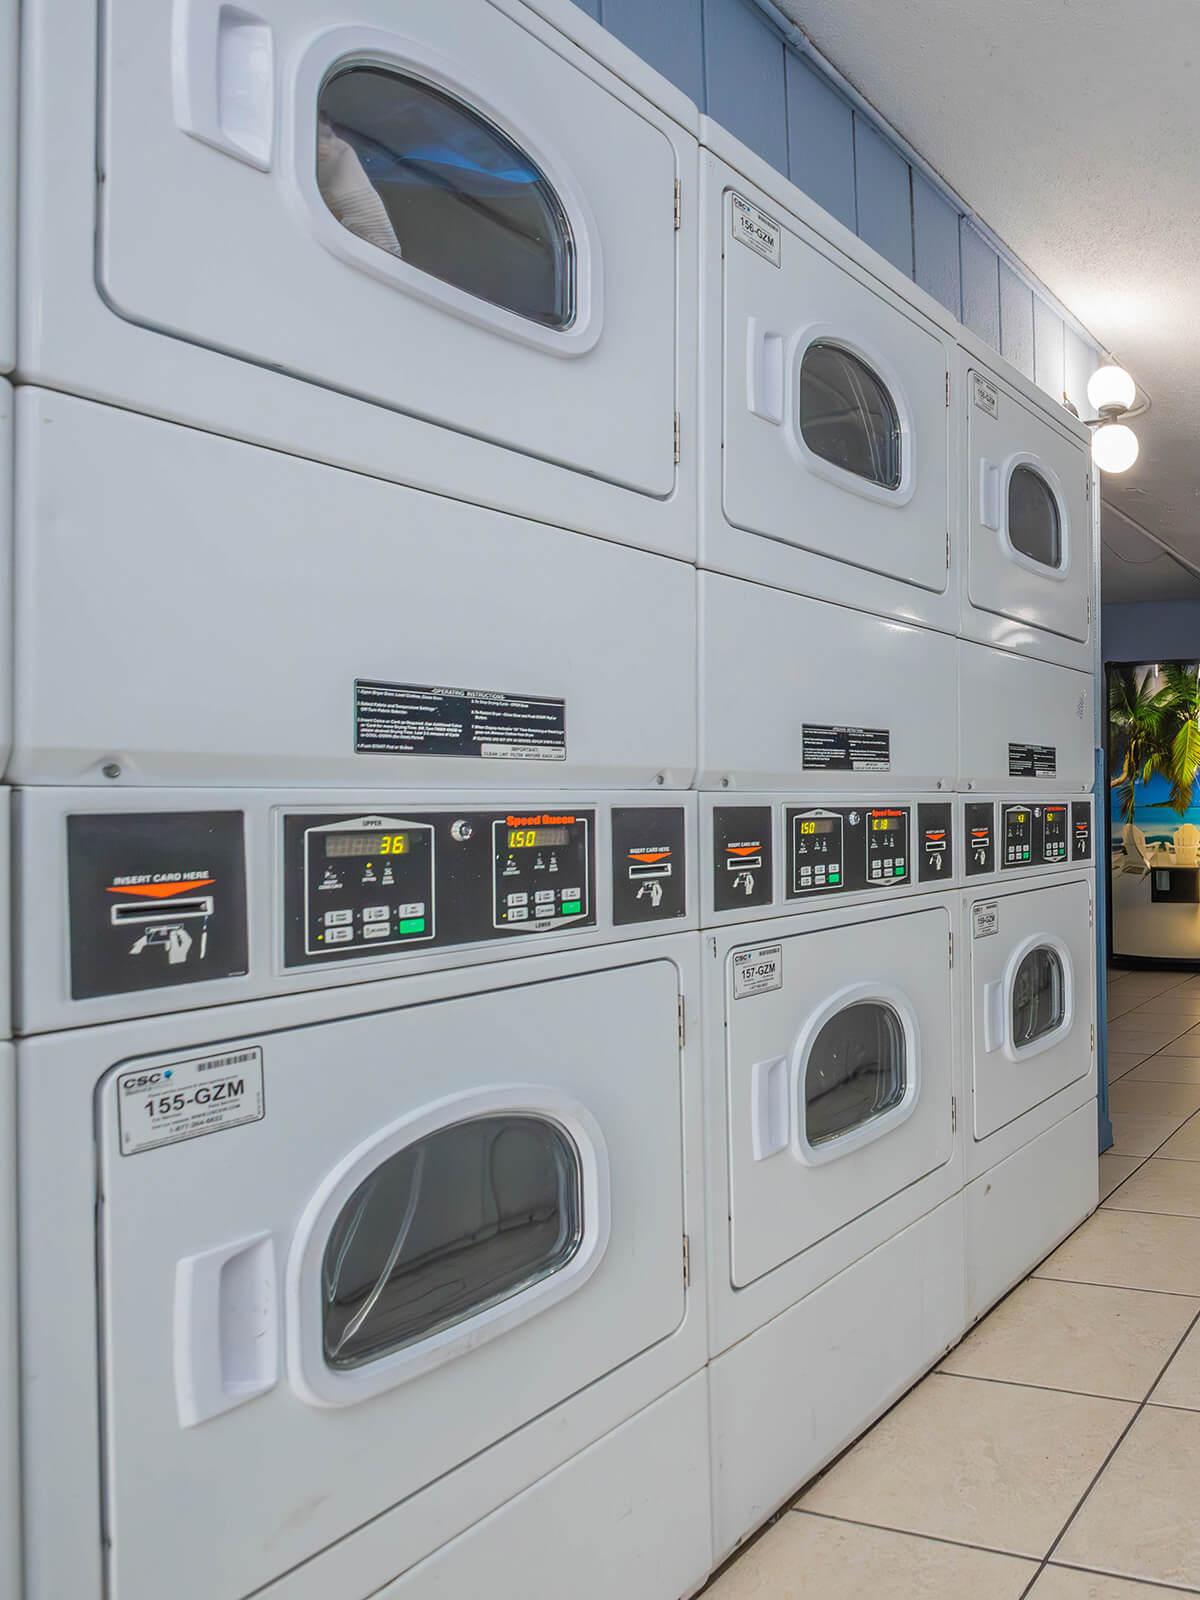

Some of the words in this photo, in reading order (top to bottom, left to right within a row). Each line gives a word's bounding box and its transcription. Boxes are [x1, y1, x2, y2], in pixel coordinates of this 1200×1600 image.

[506, 815, 541, 828] Speed
[542, 814, 575, 825] Queen
[379, 835, 404, 855] 36
[113, 874, 152, 886] INSERT
[152, 871, 182, 883] CARD
[182, 869, 209, 881] HERE
[742, 963, 776, 979] 157-GZM
[123, 1073, 161, 1089] CSC
[144, 1079, 245, 1117] 155-GZM
